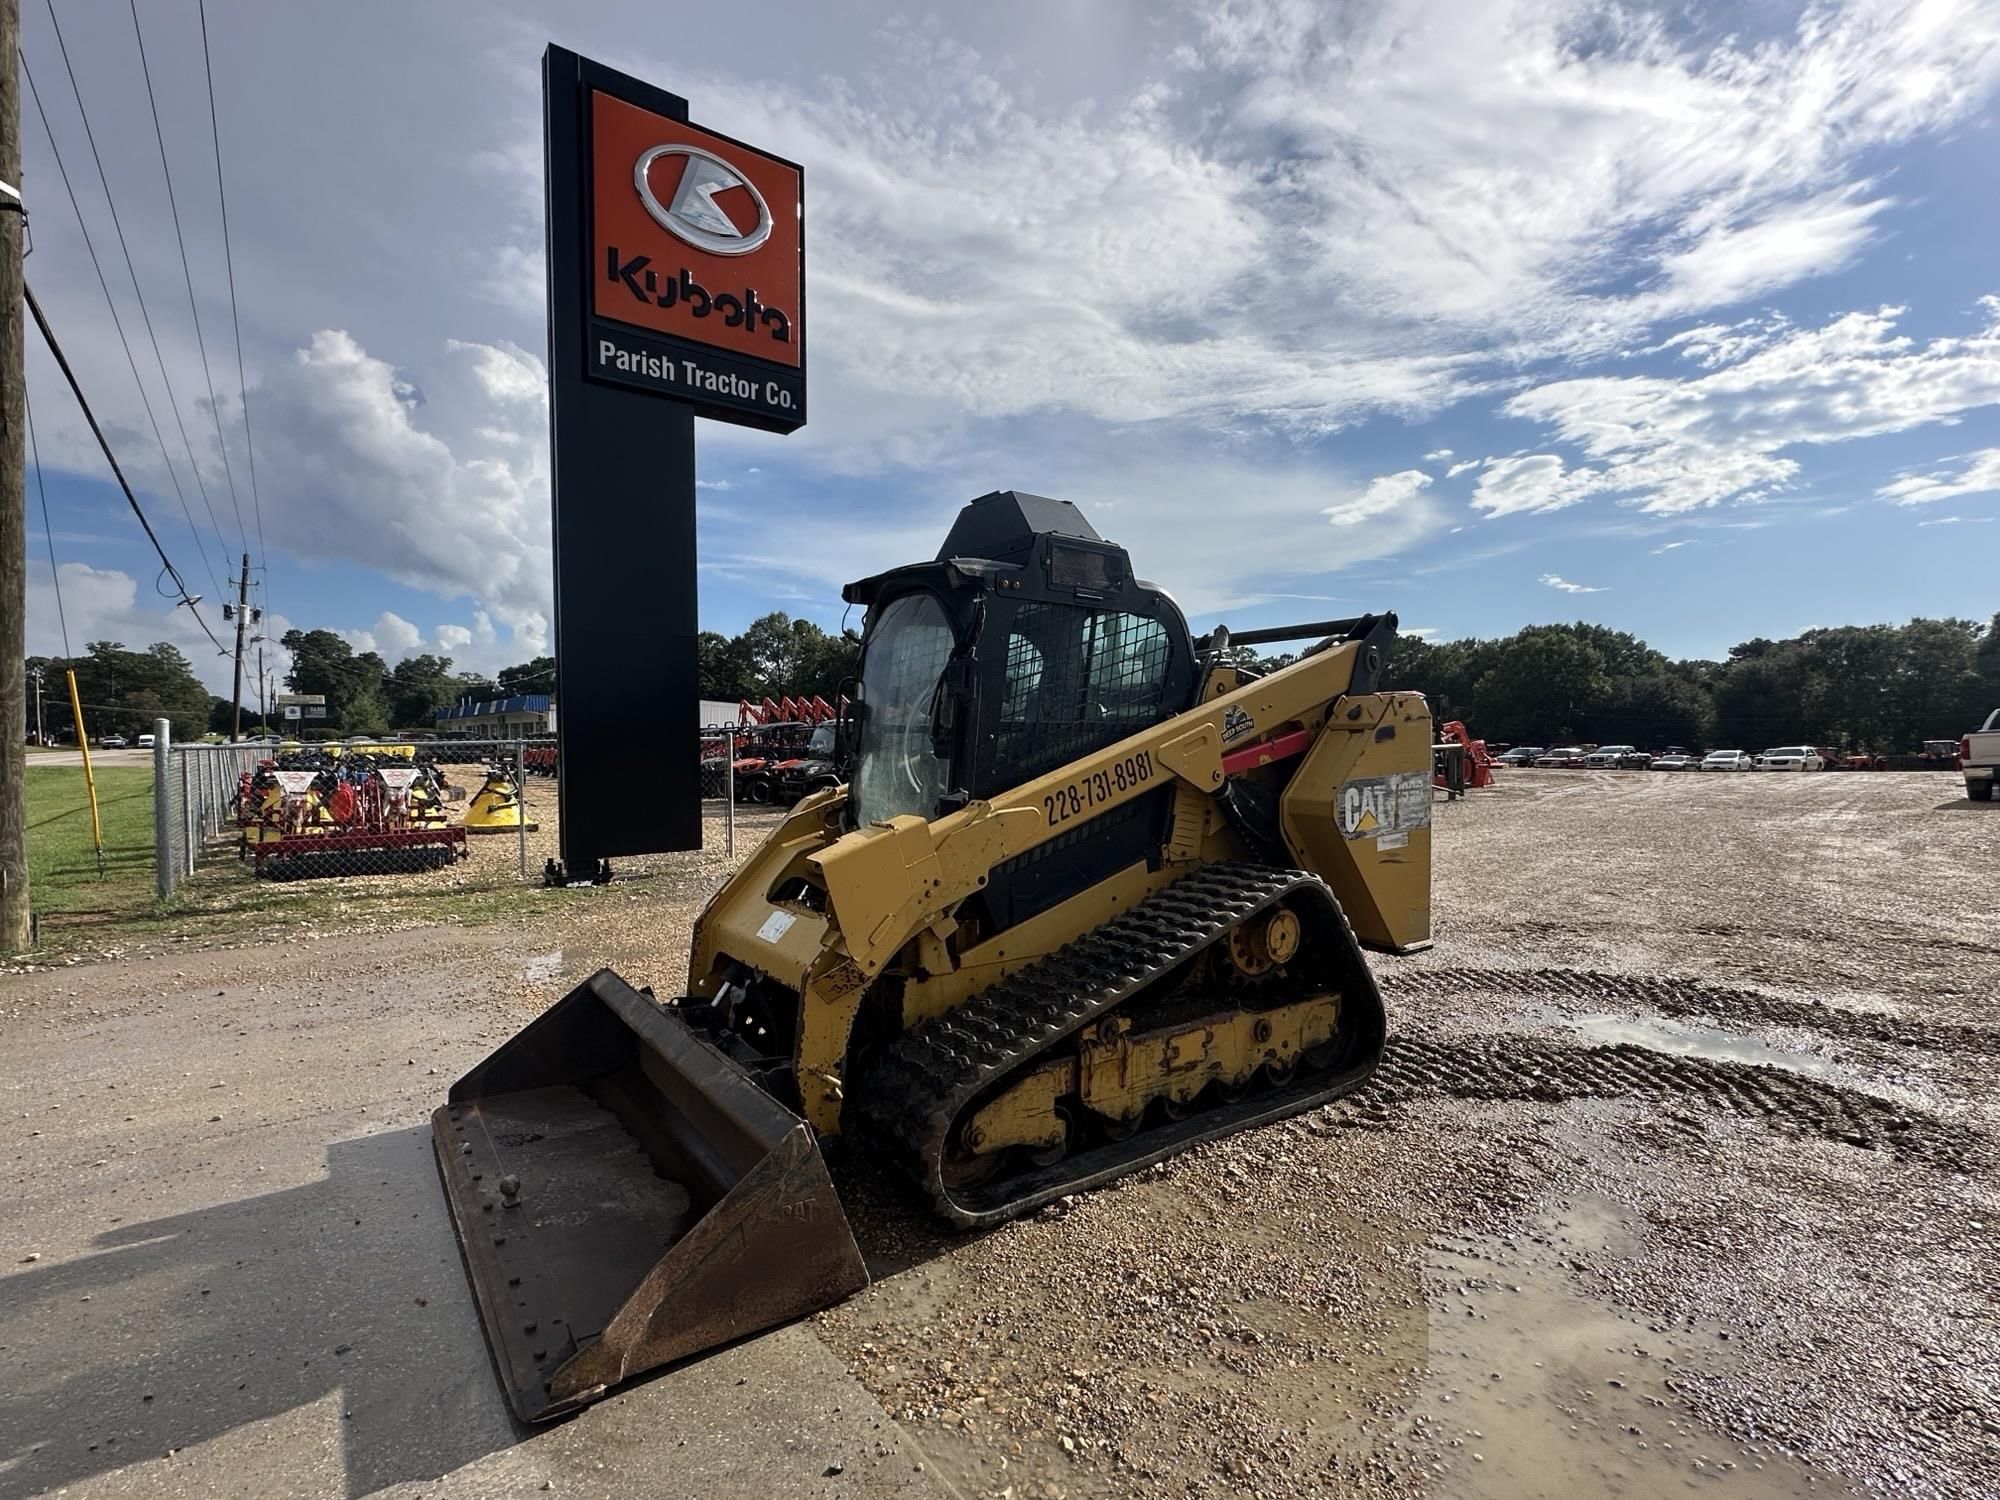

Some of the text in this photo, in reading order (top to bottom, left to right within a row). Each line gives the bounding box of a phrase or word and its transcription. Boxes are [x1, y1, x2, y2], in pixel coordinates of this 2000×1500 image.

[607, 246, 791, 342] Kubota
[599, 339, 797, 410] Parish Tractor Co.
[1236, 720, 1253, 733] SOUTH
[1044, 749, 1154, 827] 228-731-8981
[1344, 784, 1387, 833] CAT
